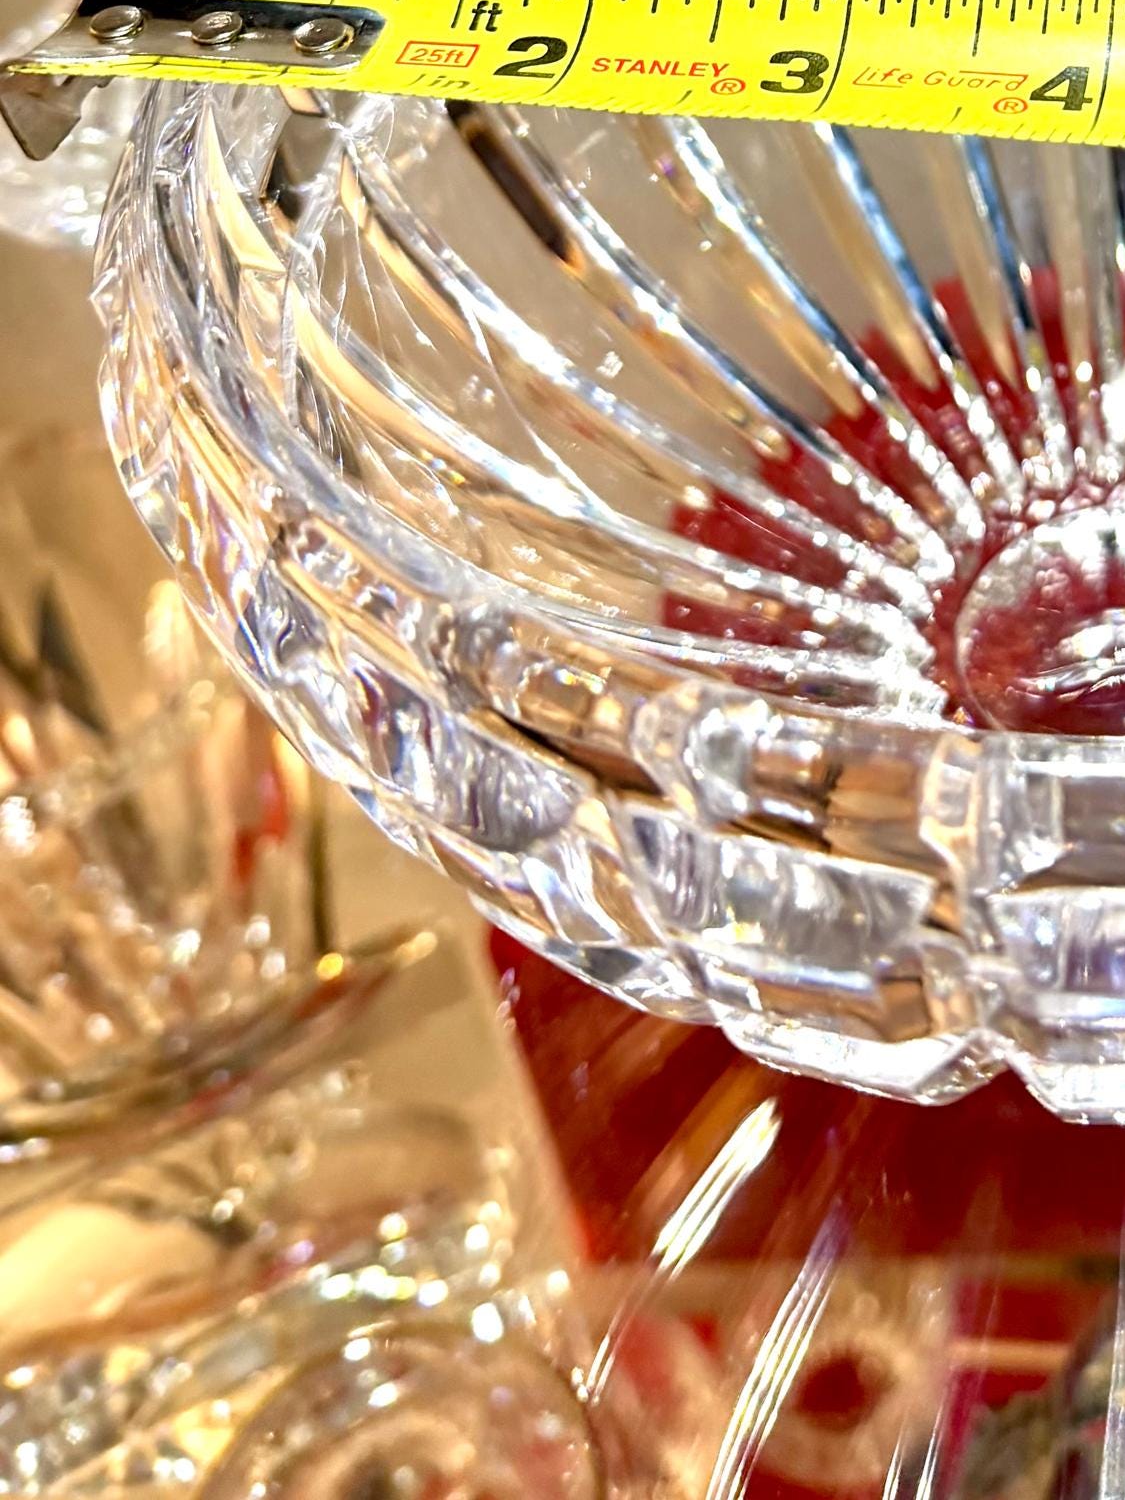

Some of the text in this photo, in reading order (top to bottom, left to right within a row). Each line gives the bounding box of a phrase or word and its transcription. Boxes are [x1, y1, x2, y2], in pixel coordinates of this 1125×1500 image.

[469, 0, 503, 33] ft
[409, 47, 466, 65] 25ft
[492, 36, 569, 79] 2
[591, 56, 730, 78] STANLEY
[428, 75, 471, 89] in
[760, 50, 830, 94] 3
[852, 66, 1028, 92] Life Guard
[1029, 66, 1093, 111] 4
